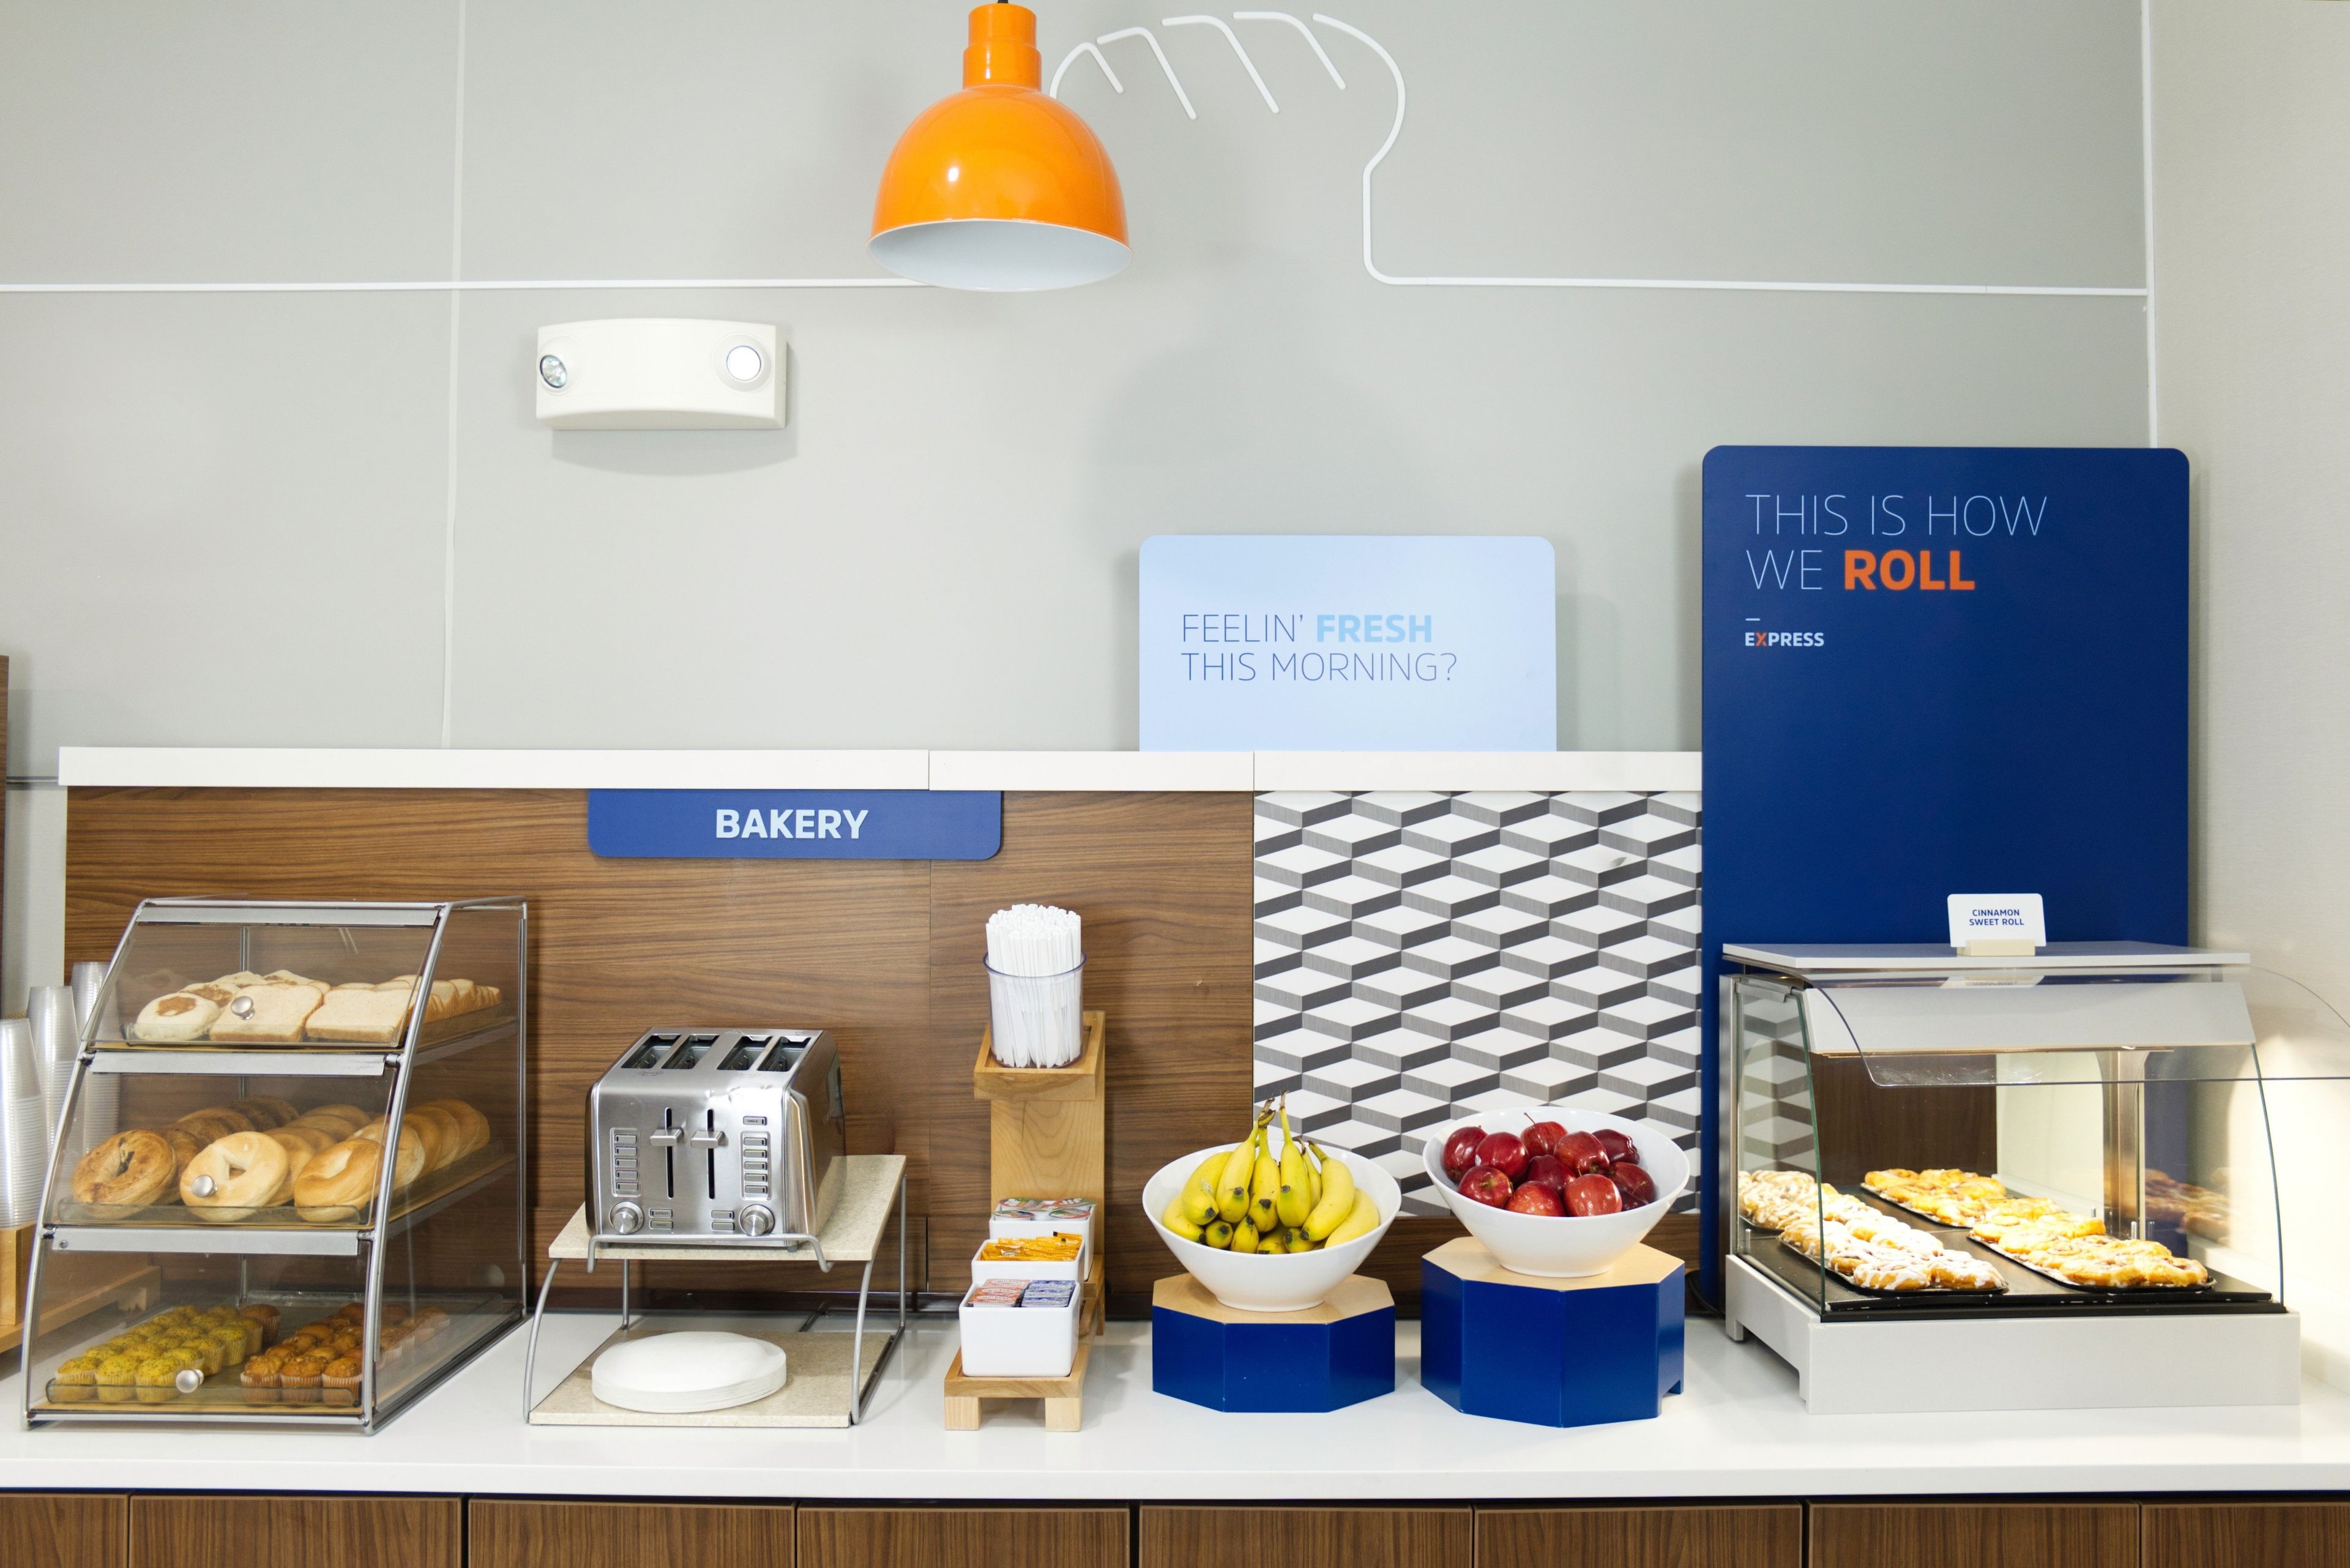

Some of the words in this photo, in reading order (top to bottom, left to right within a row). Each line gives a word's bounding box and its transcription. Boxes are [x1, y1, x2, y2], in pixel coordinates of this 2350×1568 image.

[1745, 495, 1848, 536] THIS
[1871, 495, 1906, 536] IS
[1928, 495, 2047, 536] HOW
[1746, 550, 1822, 590] WE
[1845, 549, 1975, 591] ROLL
[1316, 614, 1432, 643] FRESH
[1745, 632, 1824, 647] EXPRESS
[1181, 652, 1256, 681] THIS
[1272, 652, 1457, 681] MORNING?
[716, 808, 869, 839] BAKERY
